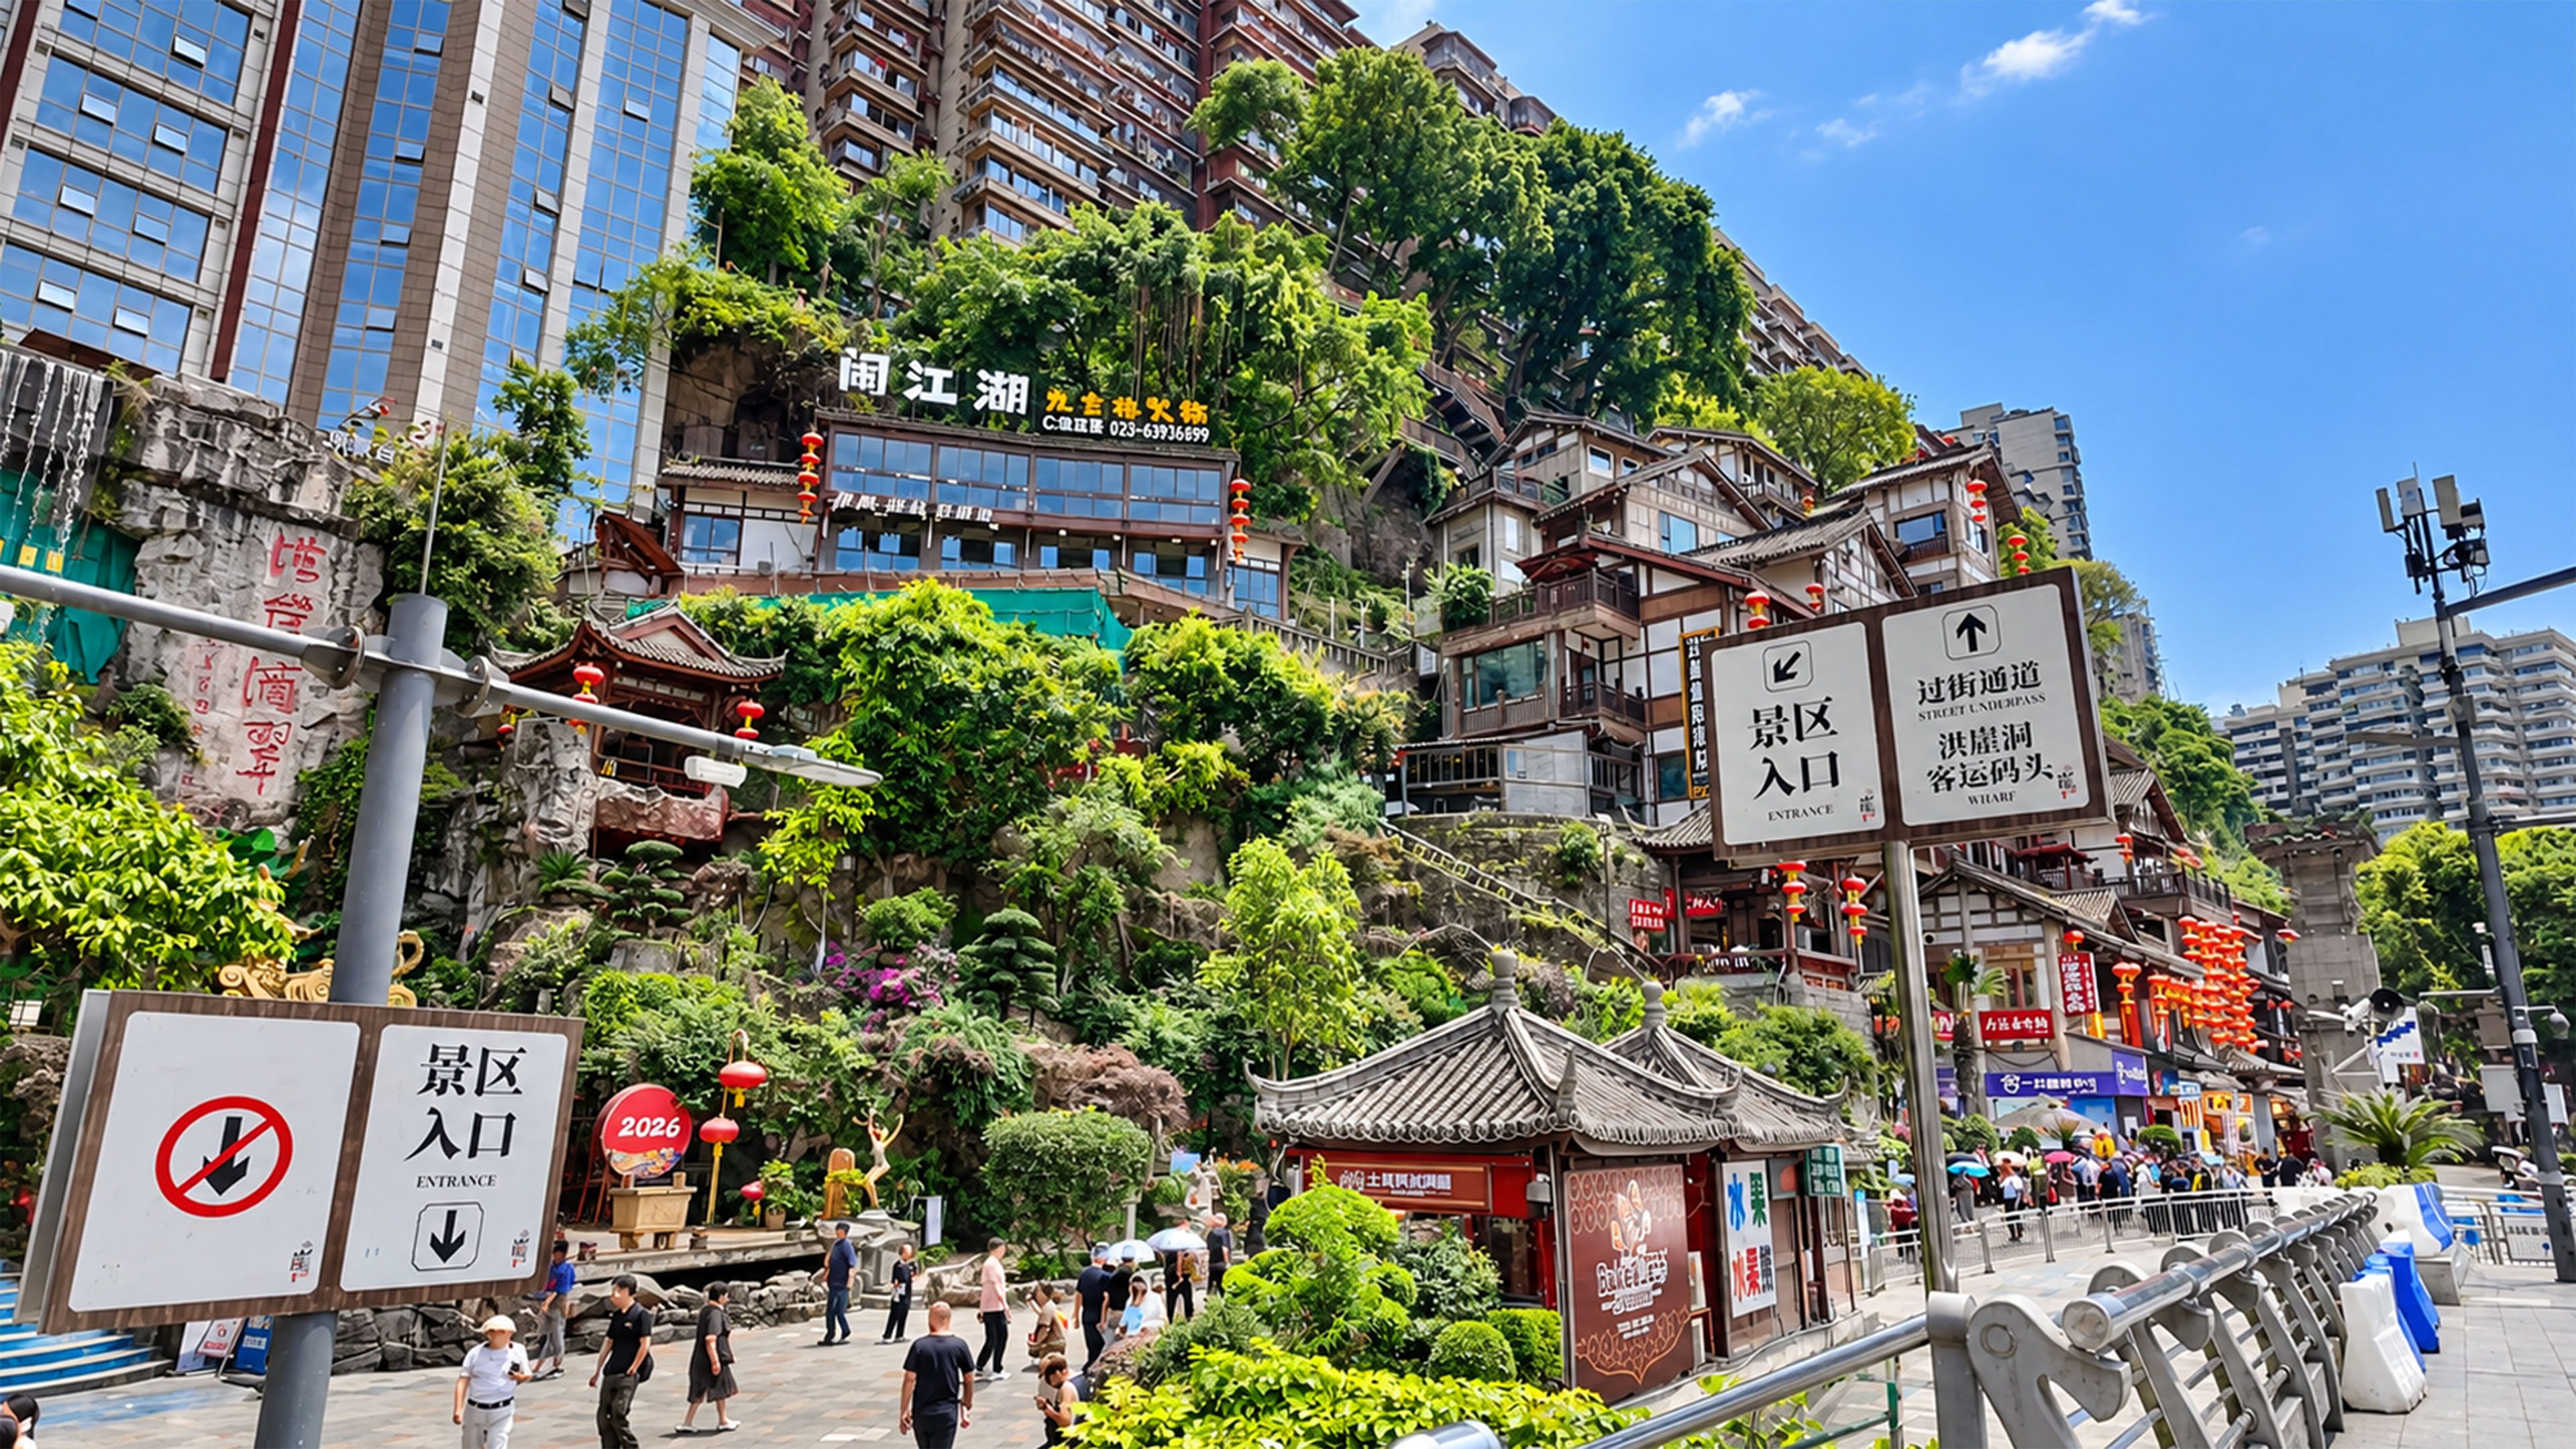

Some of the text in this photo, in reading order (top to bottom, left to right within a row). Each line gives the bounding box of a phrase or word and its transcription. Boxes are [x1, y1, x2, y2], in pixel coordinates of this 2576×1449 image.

[839, 347, 1029, 415] 闹江湖
[1918, 659, 2042, 706] 过街通道
[1748, 696, 1839, 752] 景区
[1919, 692, 2047, 722] STREET UNDERPASS
[1938, 720, 2033, 761] 洪崖洞
[1753, 751, 1840, 800] 入口
[1927, 753, 2054, 794] 客运码头
[1768, 804, 1834, 822] ENTRANCE
[1967, 790, 2017, 806] WHARF
[417, 1043, 527, 1097] 景区
[405, 1107, 517, 1161] 入口
[617, 1116, 681, 1138] 2026
[416, 1173, 497, 1189] ENTRANCE
